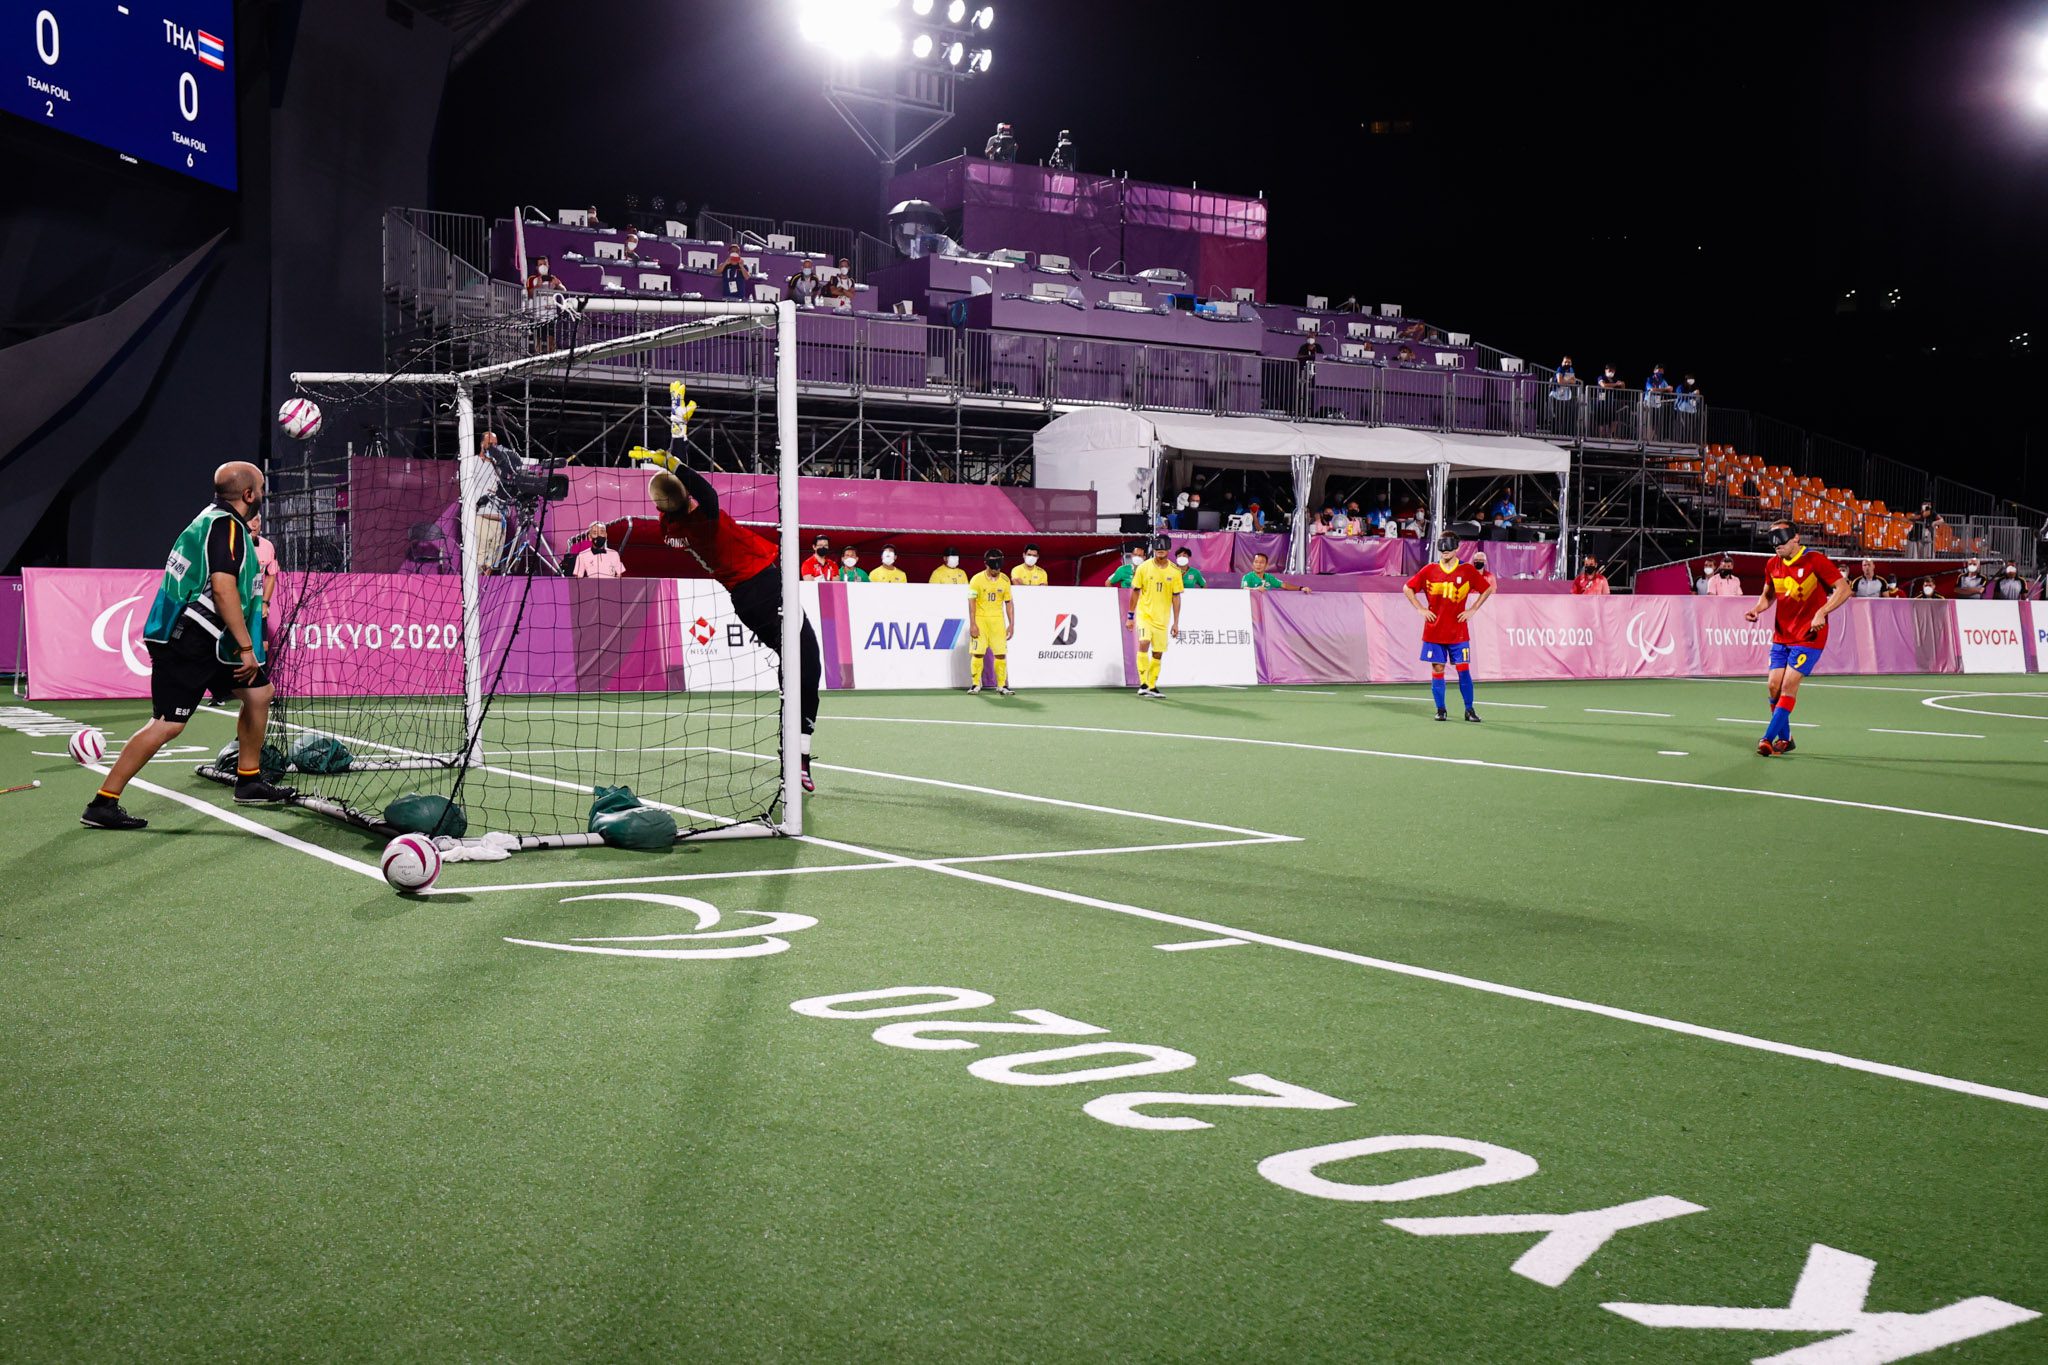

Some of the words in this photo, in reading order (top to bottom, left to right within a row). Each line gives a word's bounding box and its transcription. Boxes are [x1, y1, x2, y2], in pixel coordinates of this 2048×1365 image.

[36, 10, 60, 66] 0
[163, 19, 197, 55] THA
[27, 75, 50, 94] TEAM
[51, 84, 71, 102] FOUL
[179, 72, 199, 122] 0
[46, 100, 54, 118] 2
[172, 131, 190, 147] TEAM
[190, 137, 207, 153] FOUL
[187, 153, 194, 168] 6
[1156, 582, 1164, 593] 11
[1442, 581, 1454, 599] 11
[1783, 576, 1793, 597] 9
[987, 592, 996, 602] 10
[285, 624, 382, 649] TOKYO
[389, 624, 458, 650] 2020
[864, 622, 931, 649] ANA
[1175, 630, 1251, 646] 東京海上日動
[1506, 628, 1556, 648] TOKYO
[1558, 627, 1593, 646] 2020
[1705, 628, 1748, 646] TOKYO
[1751, 628, 1773, 646] 202
[1964, 629, 2019, 646] TOYOTA
[1038, 650, 1094, 660] BRIDGESTONE
[1794, 653, 1807, 669] 9
[790, 985, 1358, 1131] 2020
